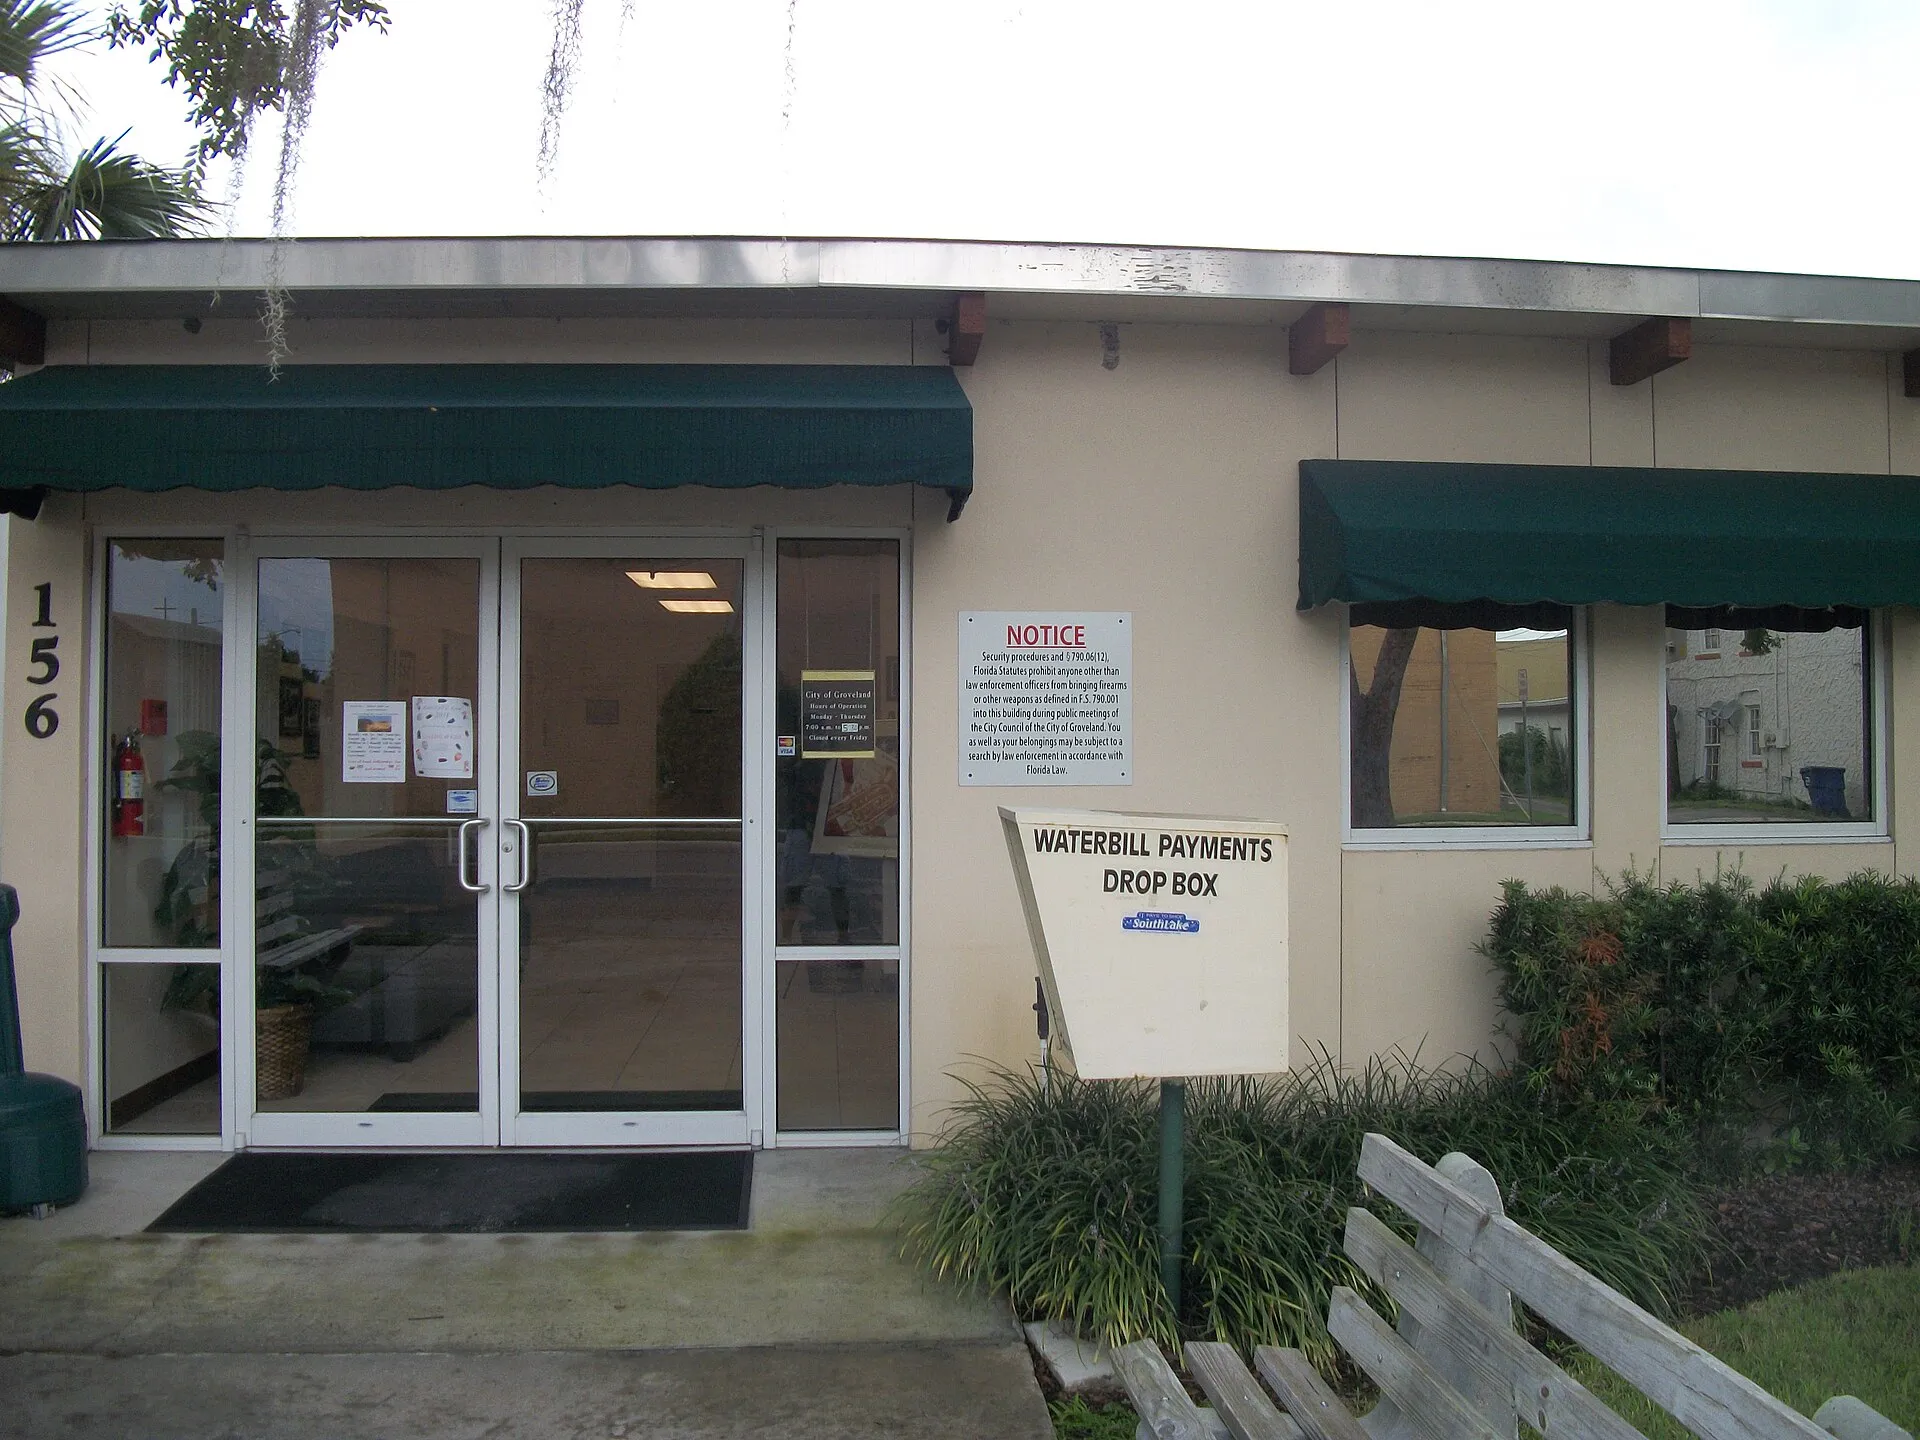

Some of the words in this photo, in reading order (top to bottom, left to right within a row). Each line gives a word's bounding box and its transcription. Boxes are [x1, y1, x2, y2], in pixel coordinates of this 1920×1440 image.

[1007, 625, 1086, 646] NOTICE
[24, 582, 60, 738] 156
[982, 652, 1010, 663] Security
[1012, 652, 1049, 663] procedures
[1051, 652, 1063, 661] and
[974, 666, 997, 675] Florida
[999, 666, 1027, 675] Statutes
[1029, 666, 1056, 678] prohibit
[1058, 668, 1082, 677] anyone
[1084, 666, 1102, 675] other
[1104, 666, 1119, 675] than
[966, 680, 978, 689] law
[980, 680, 1023, 689] enforcement
[1025, 680, 1049, 689] officers
[1051, 680, 1067, 689] from
[1069, 680, 1097, 692] bringing
[1100, 680, 1127, 689] firearms
[806, 691, 820, 699] City
[983, 694, 1001, 703] other
[1003, 696, 1033, 706] weapons
[1044, 694, 1069, 703] defined
[1071, 694, 1077, 703] in
[1080, 694, 1091, 703] F.S.
[1093, 694, 1118, 703] 790.001
[973, 708, 987, 717] into
[989, 708, 1000, 717] this
[1003, 708, 1030, 720] building
[1033, 708, 1055, 720] during
[1057, 708, 1077, 720] public
[1079, 708, 1110, 720] meetings
[1112, 708, 1118, 717] of
[971, 722, 982, 732] the
[984, 722, 997, 734] City
[999, 722, 1023, 732] Council
[1025, 722, 1032, 732] of
[1034, 722, 1045, 732] the
[1047, 722, 1059, 734] City
[1061, 722, 1068, 731] of
[1070, 722, 1106, 731] Groveland.
[1108, 723, 1120, 731] You
[978, 736, 991, 746] well
[1002, 739, 1017, 748] your
[1020, 736, 1057, 748] belongings
[1059, 739, 1072, 748] may
[1075, 736, 1083, 746] be
[1085, 736, 1108, 748] subject
[969, 751, 990, 760] search
[992, 751, 1000, 762] by
[1002, 751, 1014, 760] law
[1016, 751, 1059, 760] enforcement
[1061, 751, 1067, 760] in
[1069, 751, 1106, 760] accordance
[1108, 751, 1123, 760] with
[1027, 765, 1050, 774] Florida
[1052, 765, 1067, 774] Law.
[1034, 828, 1150, 856] WATERBILL
[1158, 834, 1272, 862] PAYMENTS
[1103, 869, 1166, 894] DROP
[1172, 872, 1218, 896] BOX
[1132, 918, 1189, 930] SouthLake
